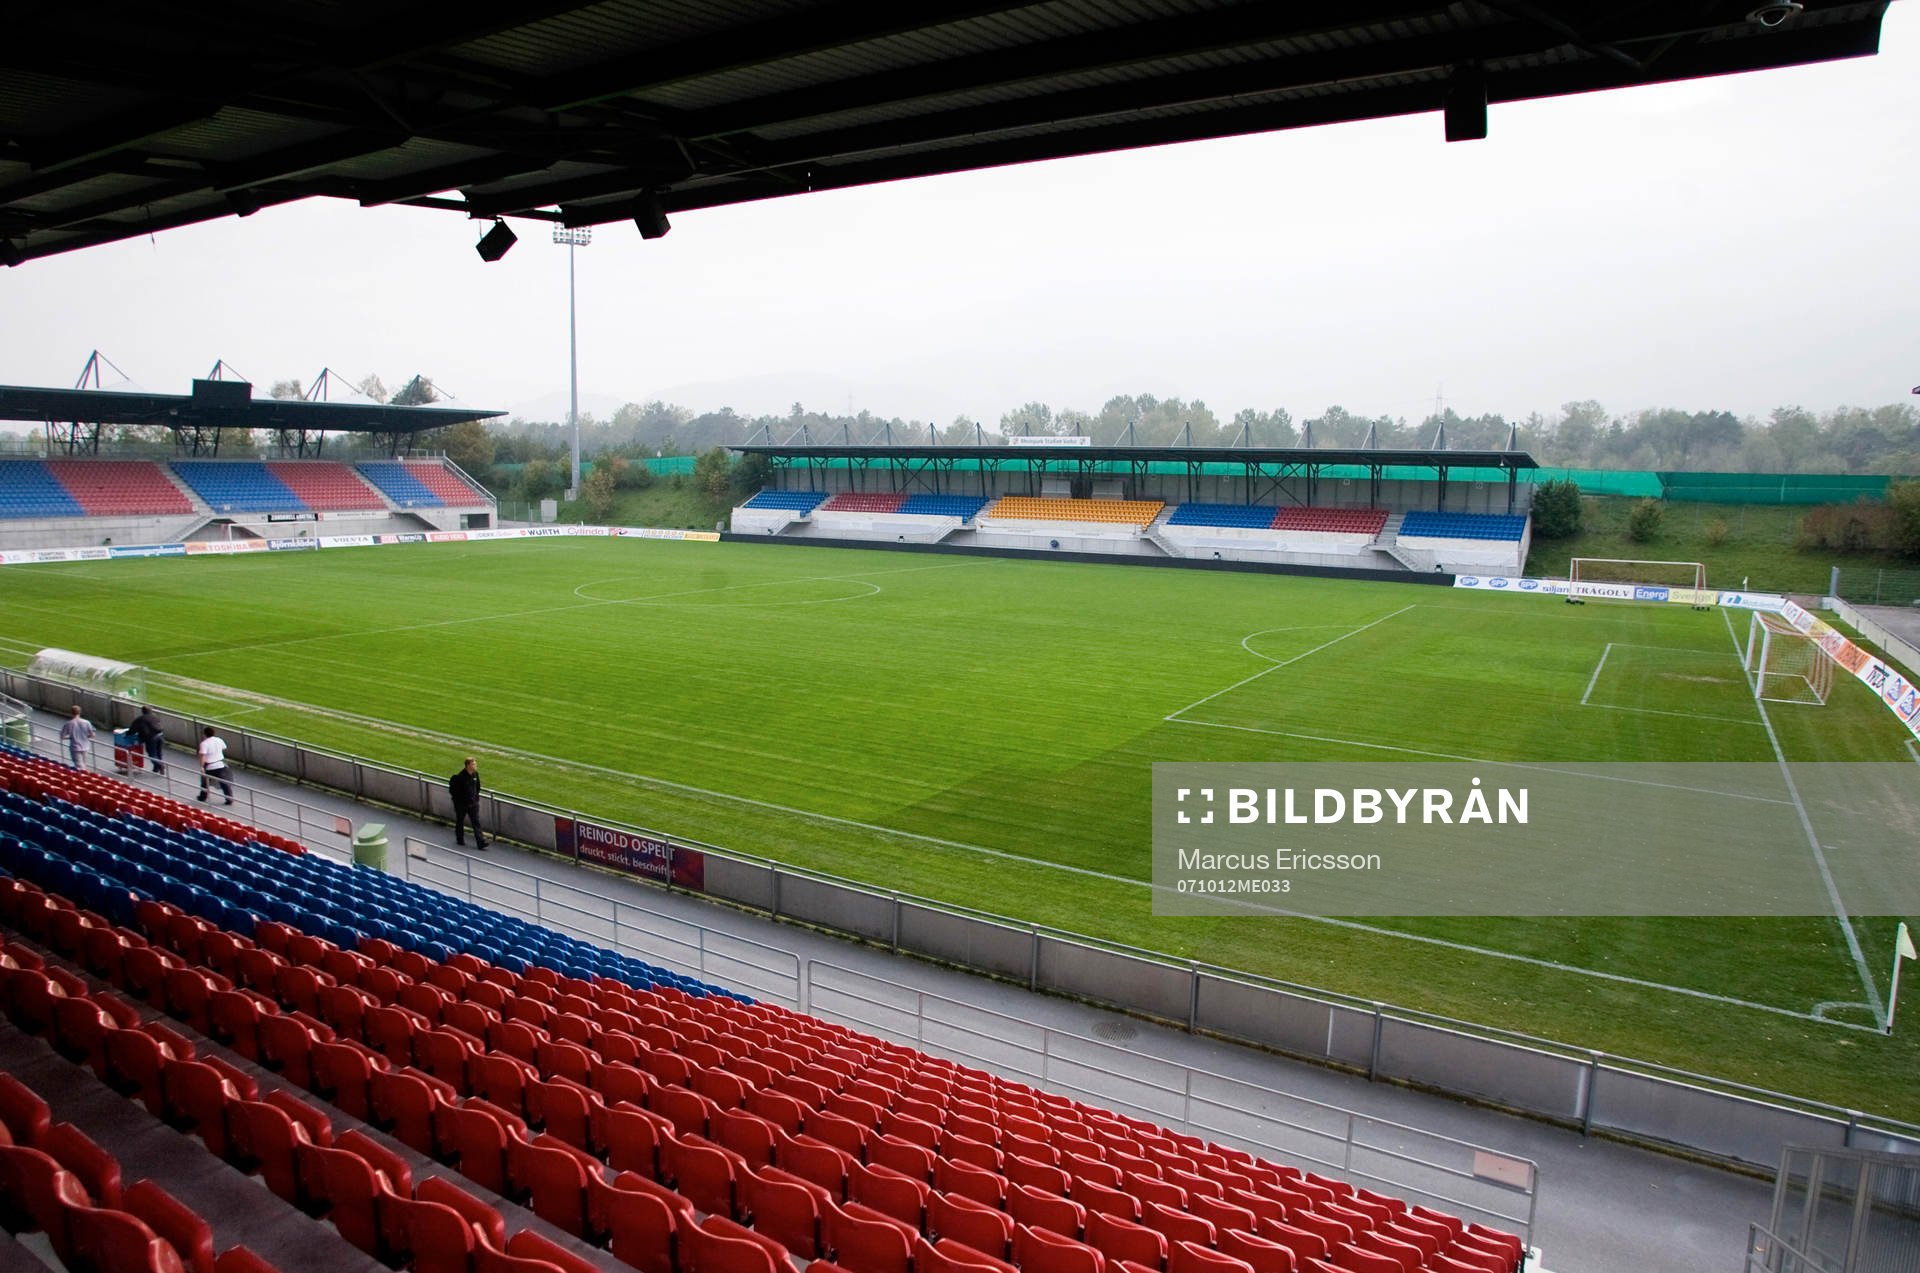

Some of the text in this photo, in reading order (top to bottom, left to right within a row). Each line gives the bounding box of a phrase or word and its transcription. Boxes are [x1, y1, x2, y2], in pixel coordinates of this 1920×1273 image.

[1636, 588, 1668, 602] Energi
[579, 825, 676, 861] REINOLD OSPELT
